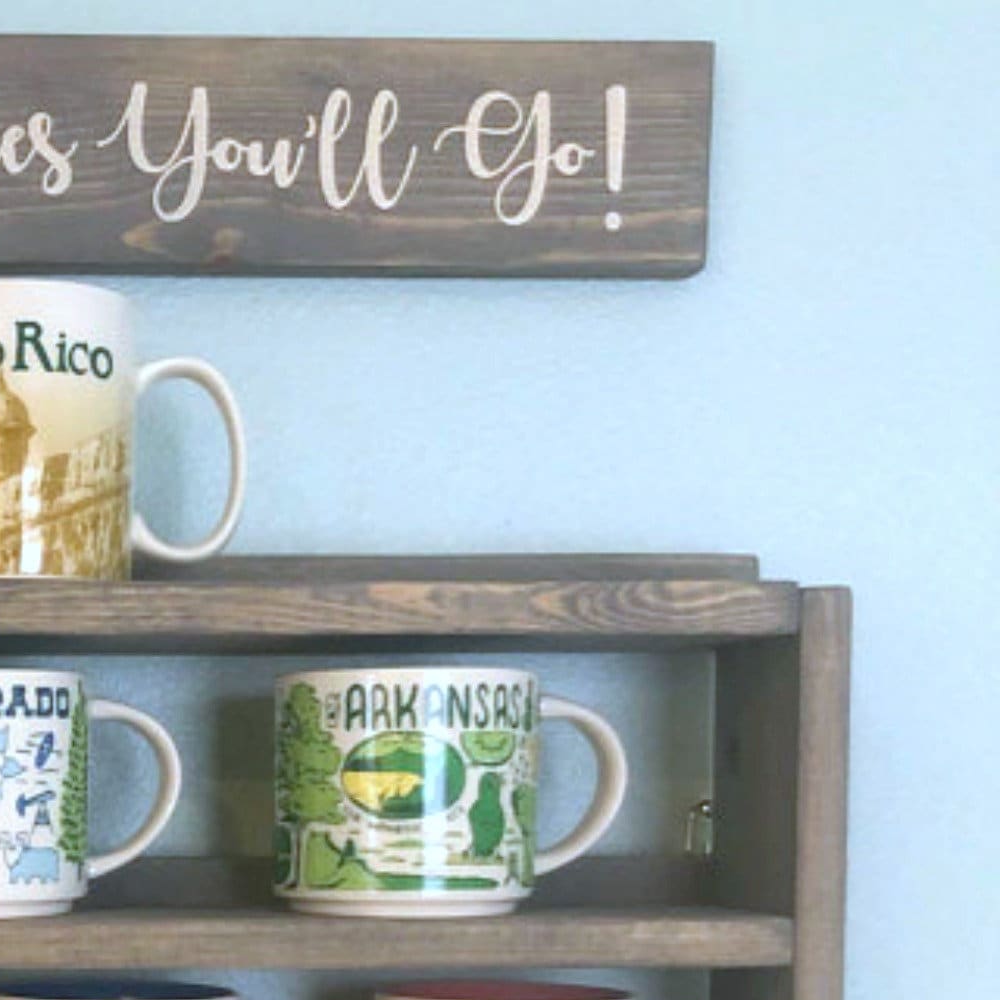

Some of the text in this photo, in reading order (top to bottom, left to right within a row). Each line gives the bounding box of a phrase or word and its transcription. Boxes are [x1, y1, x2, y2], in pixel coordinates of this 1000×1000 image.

[96, 82, 418, 223] You'll
[11, 320, 115, 380] Rico
[345, 683, 522, 732] ARKANSAS
